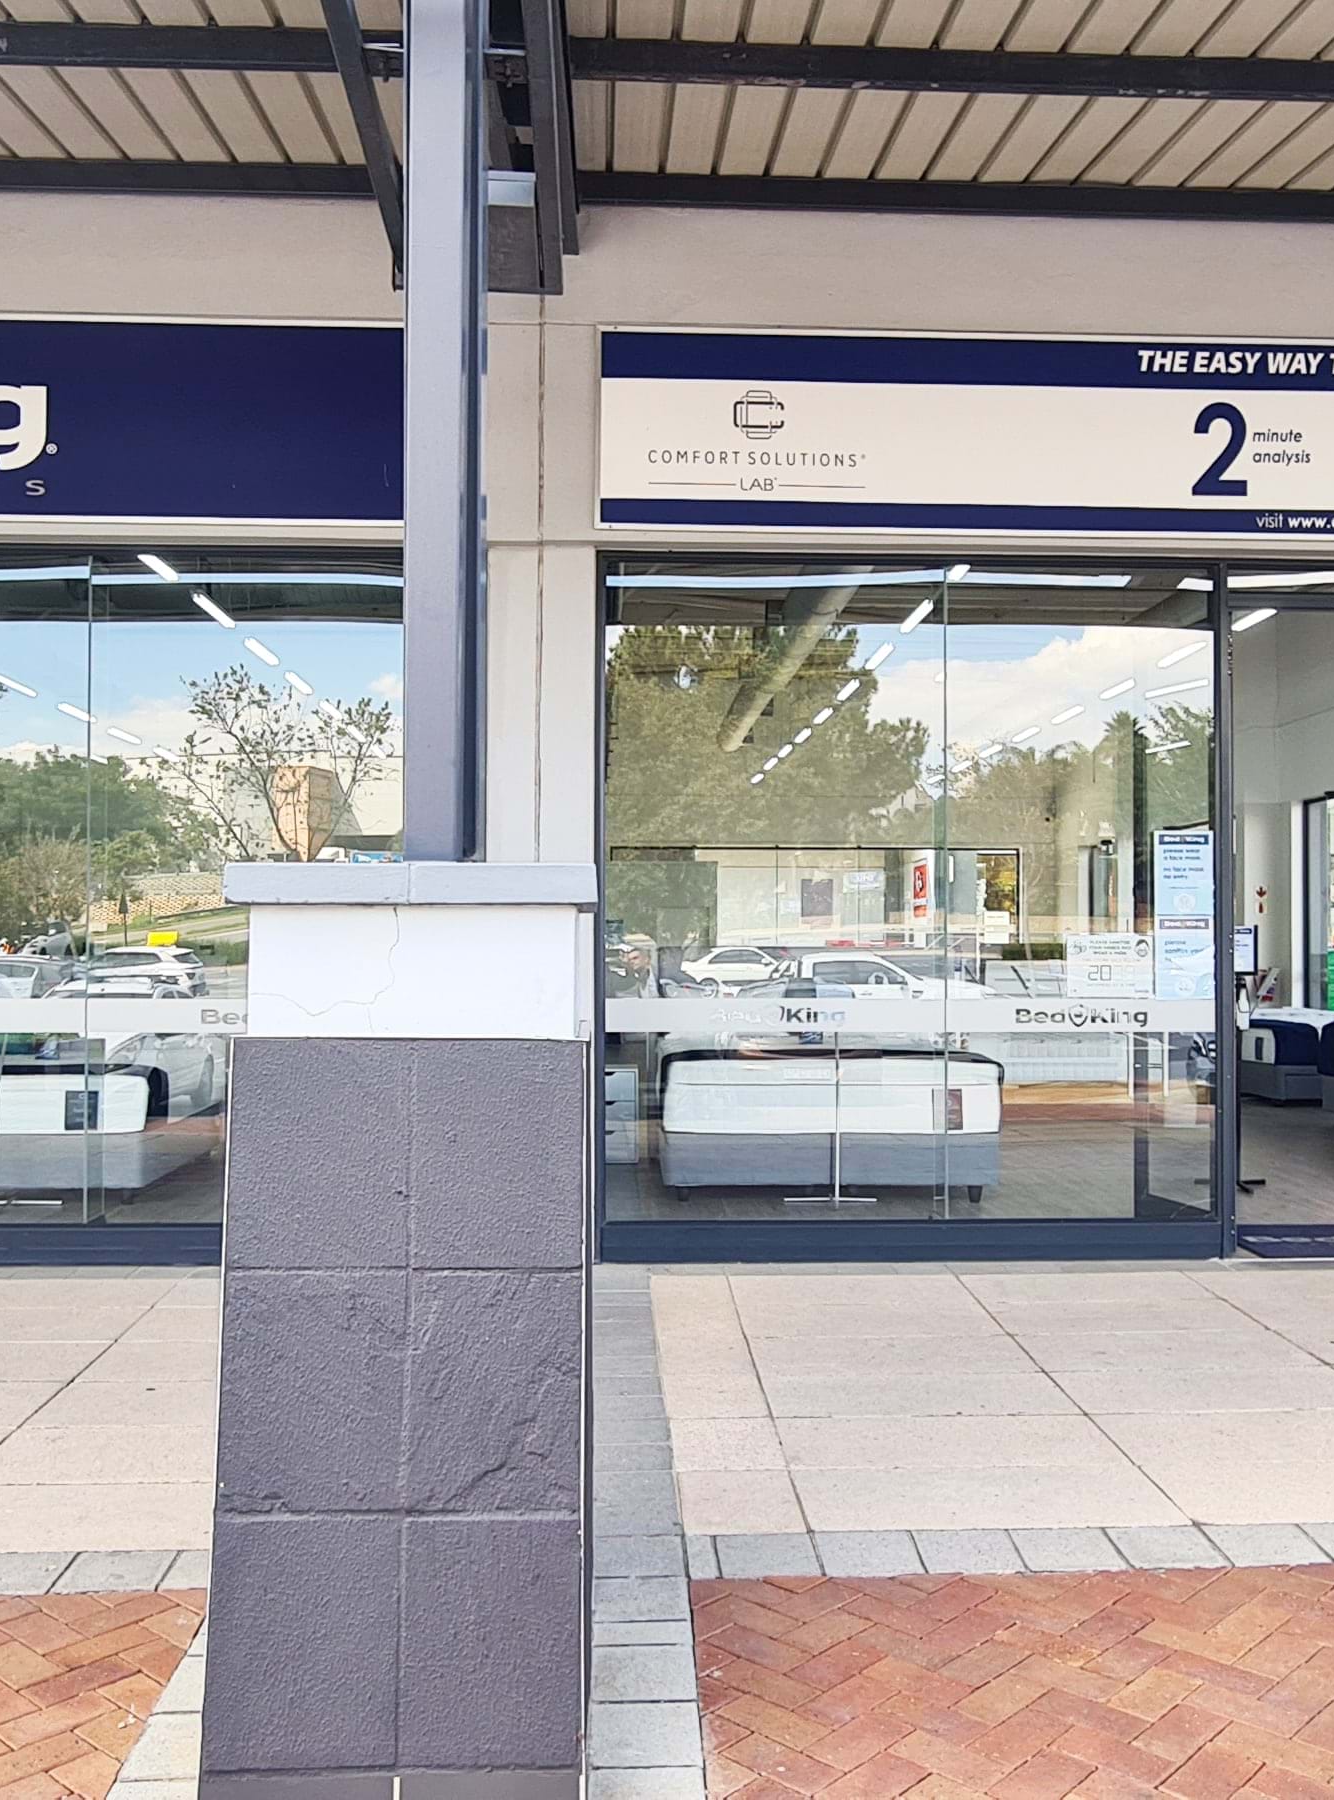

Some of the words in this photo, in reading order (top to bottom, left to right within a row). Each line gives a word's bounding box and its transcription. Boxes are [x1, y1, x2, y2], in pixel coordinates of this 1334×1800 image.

[1138, 350, 1189, 373] THE
[1193, 351, 1262, 374] EASY
[1267, 352, 1322, 375] WAY
[1252, 428, 1303, 443] minute
[648, 449, 742, 466] COMFORT
[1191, 402, 1248, 496] 2
[1252, 449, 1312, 467] analysis
[739, 477, 774, 492] LAB
[1255, 513, 1284, 529] visit
[786, 1008, 846, 1028] King
[1015, 1008, 1065, 1024] Bed
